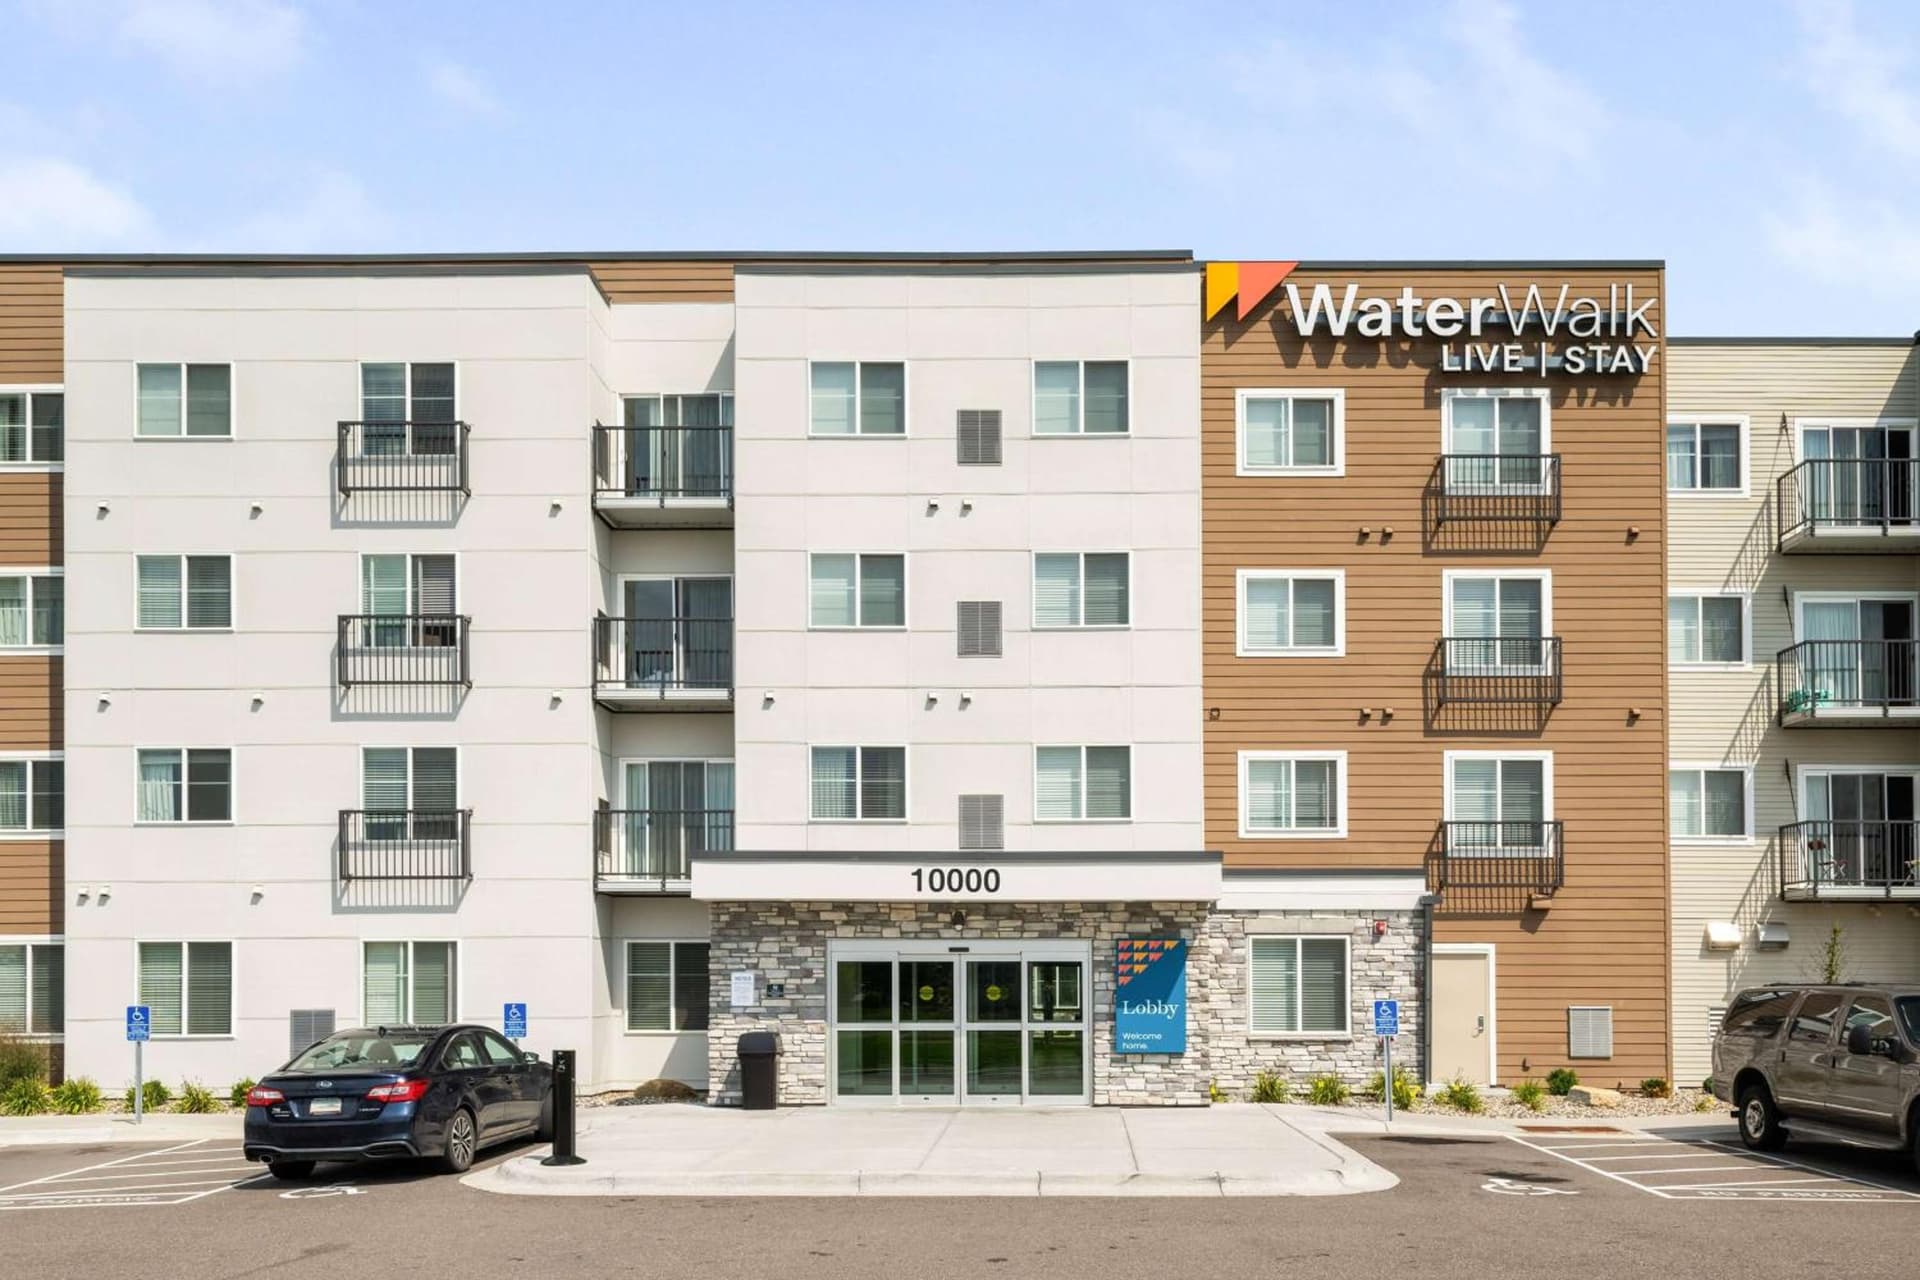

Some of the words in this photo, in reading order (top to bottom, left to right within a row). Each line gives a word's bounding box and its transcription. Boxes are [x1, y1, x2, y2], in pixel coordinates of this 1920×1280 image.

[1286, 282, 1658, 337] WaterWalk
[1441, 345, 1523, 373] LIVE
[1564, 345, 1657, 374] STAY
[911, 868, 1000, 892] 10000
[1122, 999, 1179, 1020] Lobby
[1122, 1033, 1162, 1041] Welcome
[1757, 1191, 1881, 1199] PARKING
